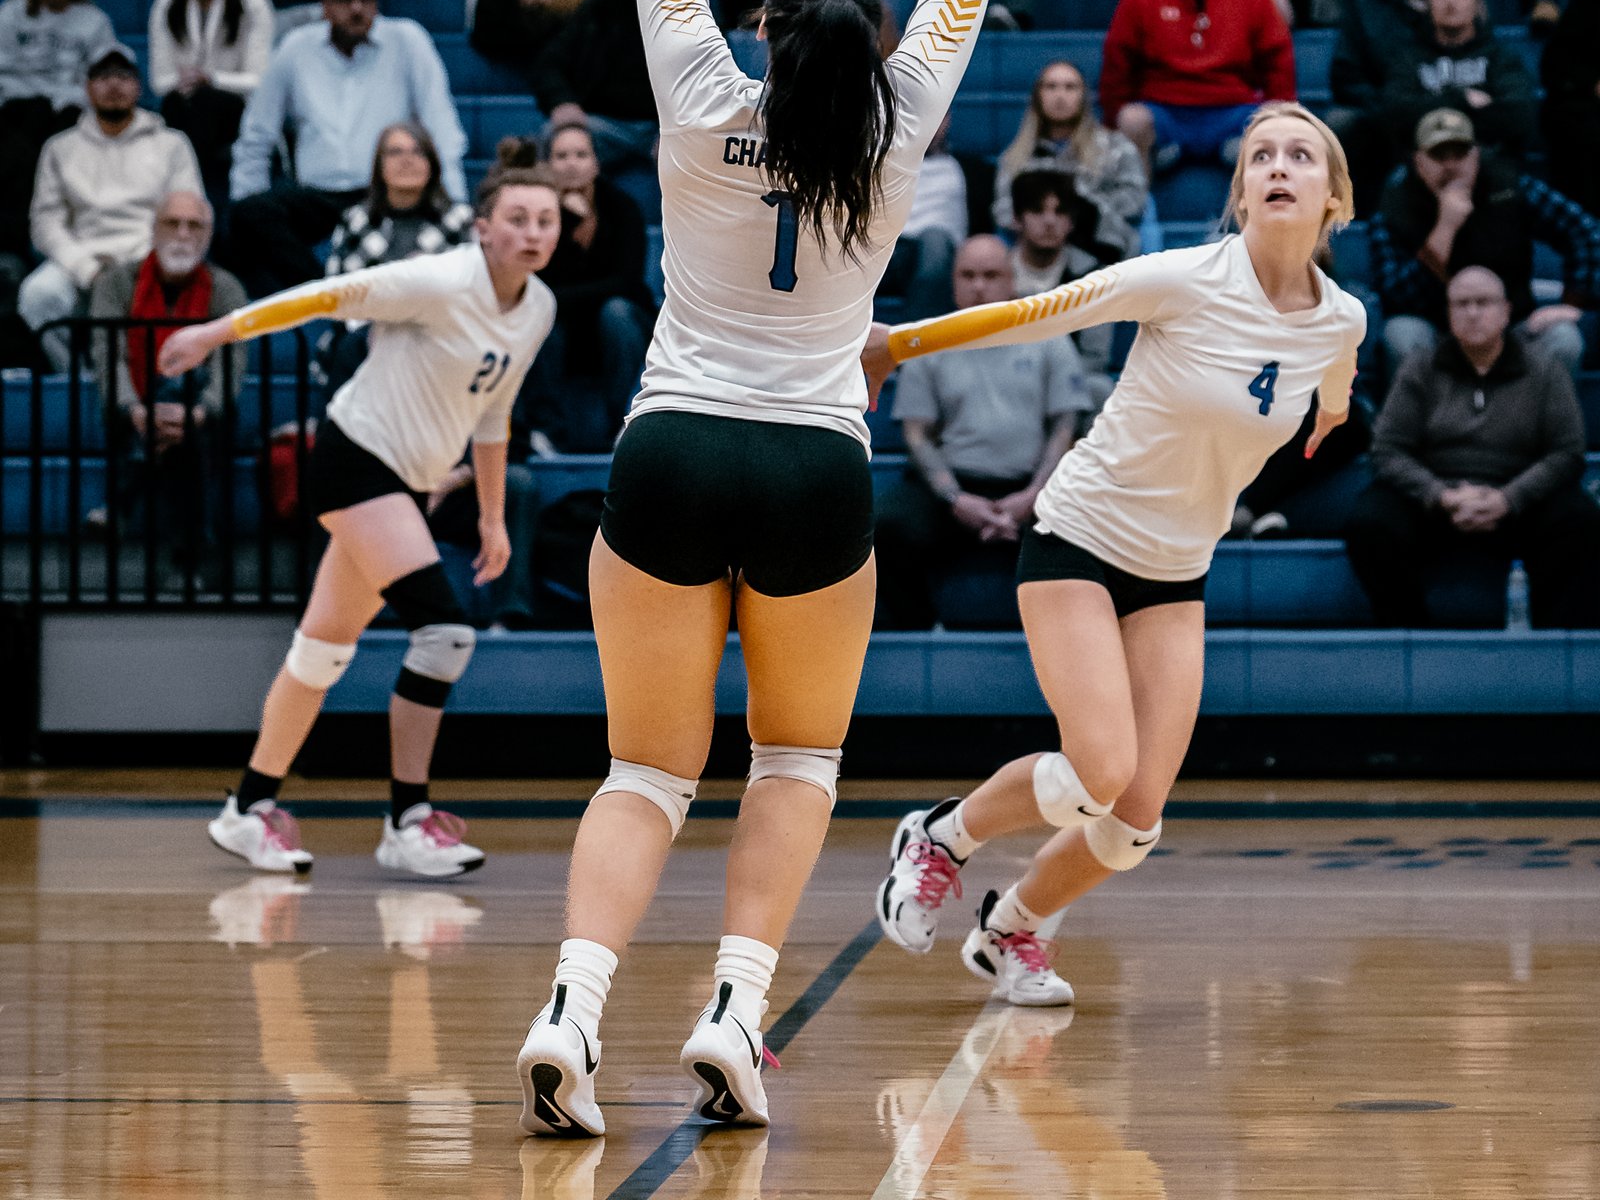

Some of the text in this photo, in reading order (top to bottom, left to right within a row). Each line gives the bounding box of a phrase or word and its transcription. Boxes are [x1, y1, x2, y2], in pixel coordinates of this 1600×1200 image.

[760, 190, 799, 292] 1
[469, 351, 509, 394] 21
[1248, 361, 1280, 416] 4
